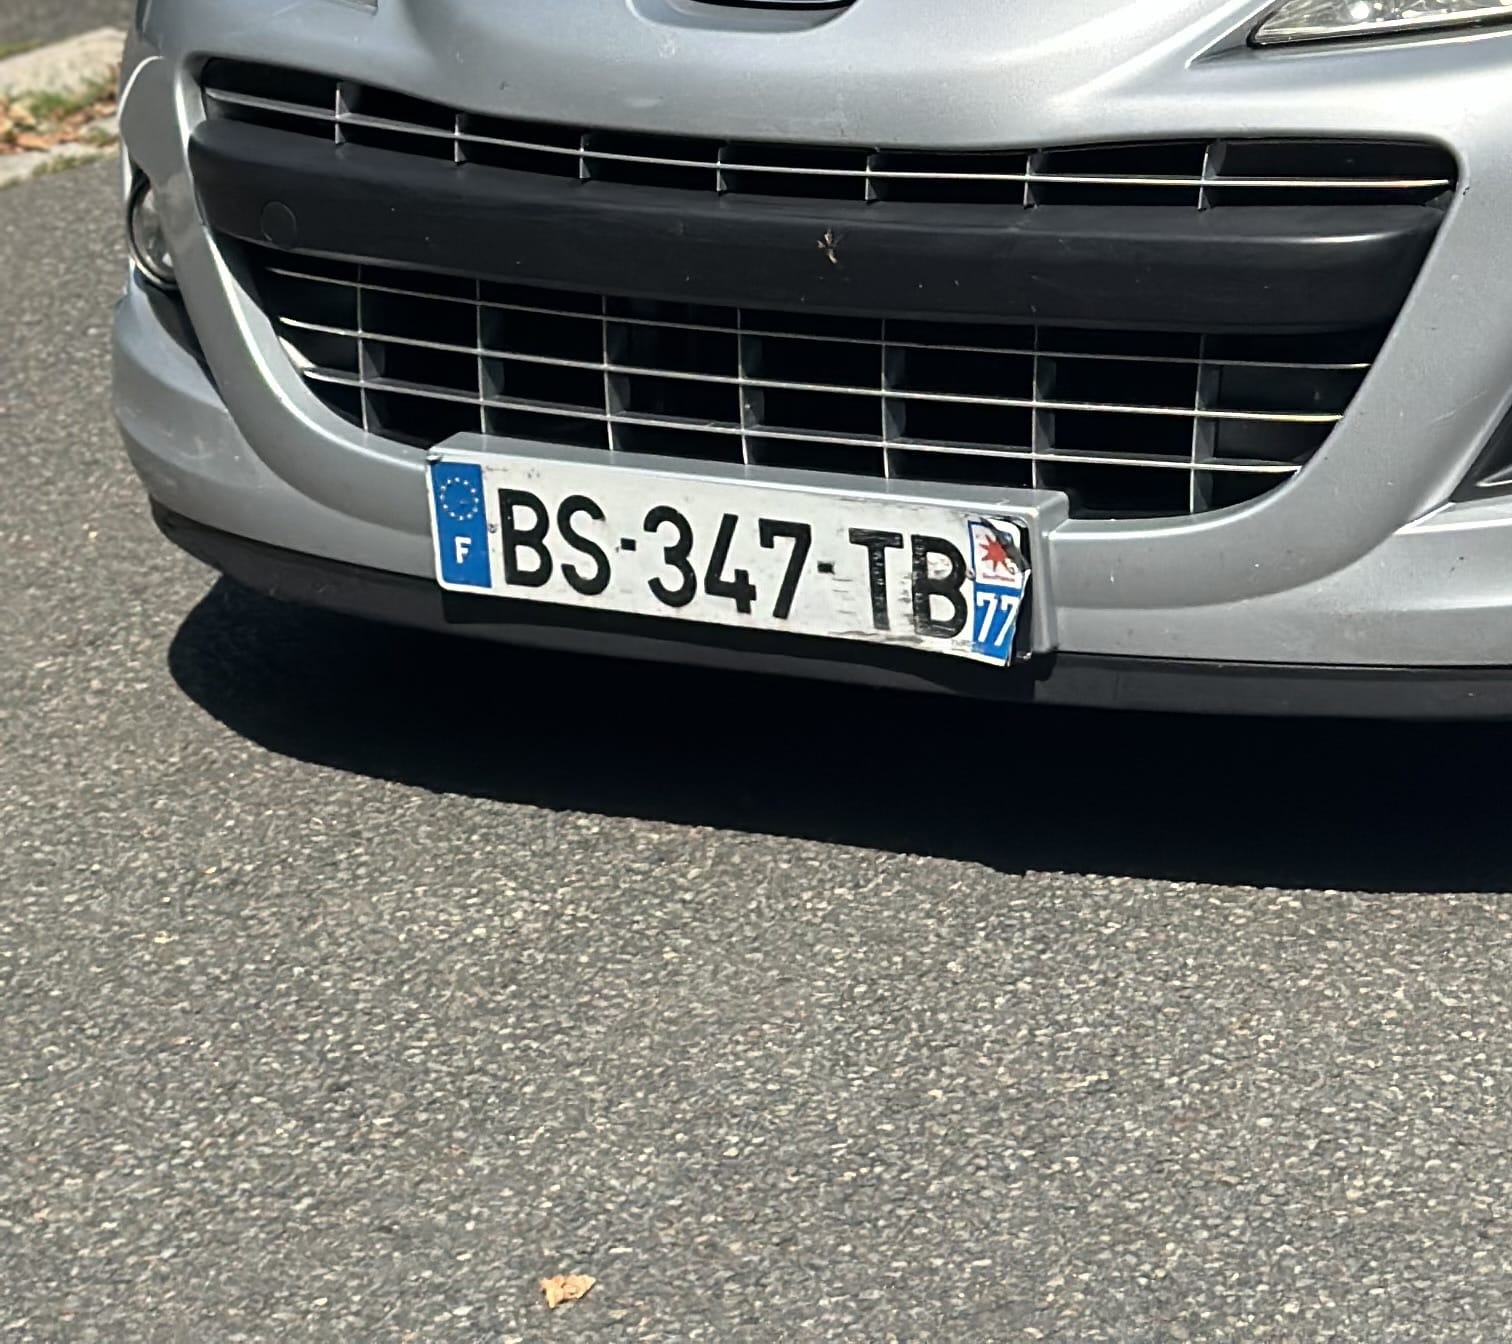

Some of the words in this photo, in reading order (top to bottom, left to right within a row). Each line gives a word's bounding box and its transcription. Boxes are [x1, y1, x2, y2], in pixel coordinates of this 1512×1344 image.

[455, 535, 472, 564] F
[498, 487, 968, 639] BS-347-TB
[976, 591, 1020, 646] 77
